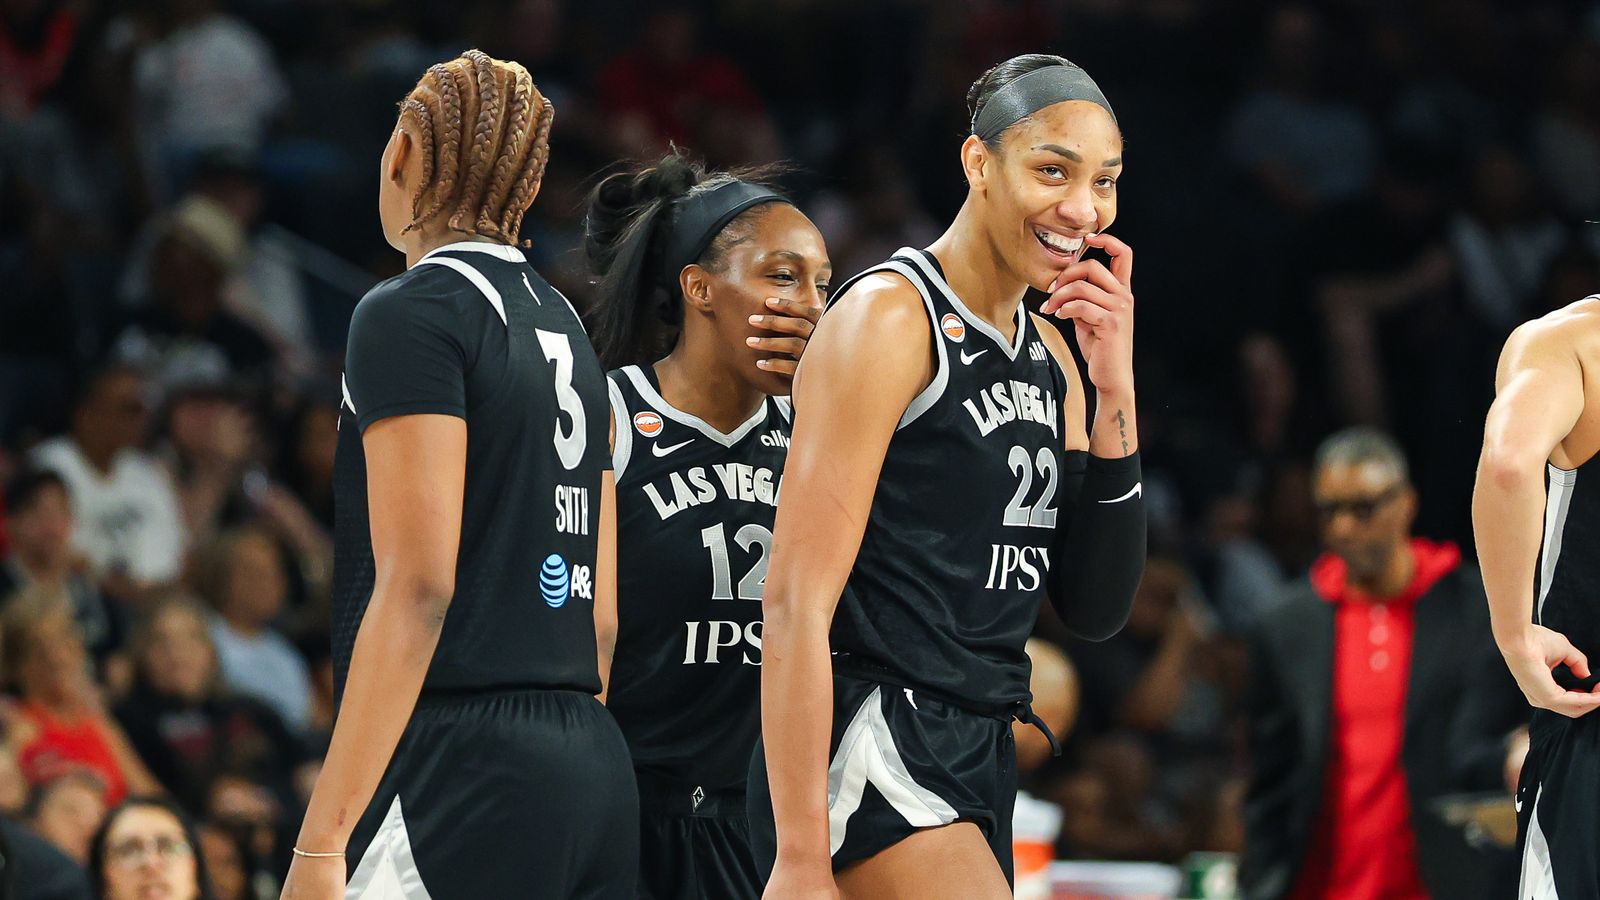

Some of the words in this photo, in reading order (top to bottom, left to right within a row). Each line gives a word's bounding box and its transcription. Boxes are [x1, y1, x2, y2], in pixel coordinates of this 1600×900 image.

[535, 328, 587, 470] 3
[962, 382, 1016, 437] LAS
[555, 484, 588, 535] SITH
[642, 467, 717, 520] LAS
[712, 463, 784, 507] VEG
[1002, 445, 1058, 529] 22
[701, 522, 774, 600] 12
[682, 620, 763, 666] IPS
